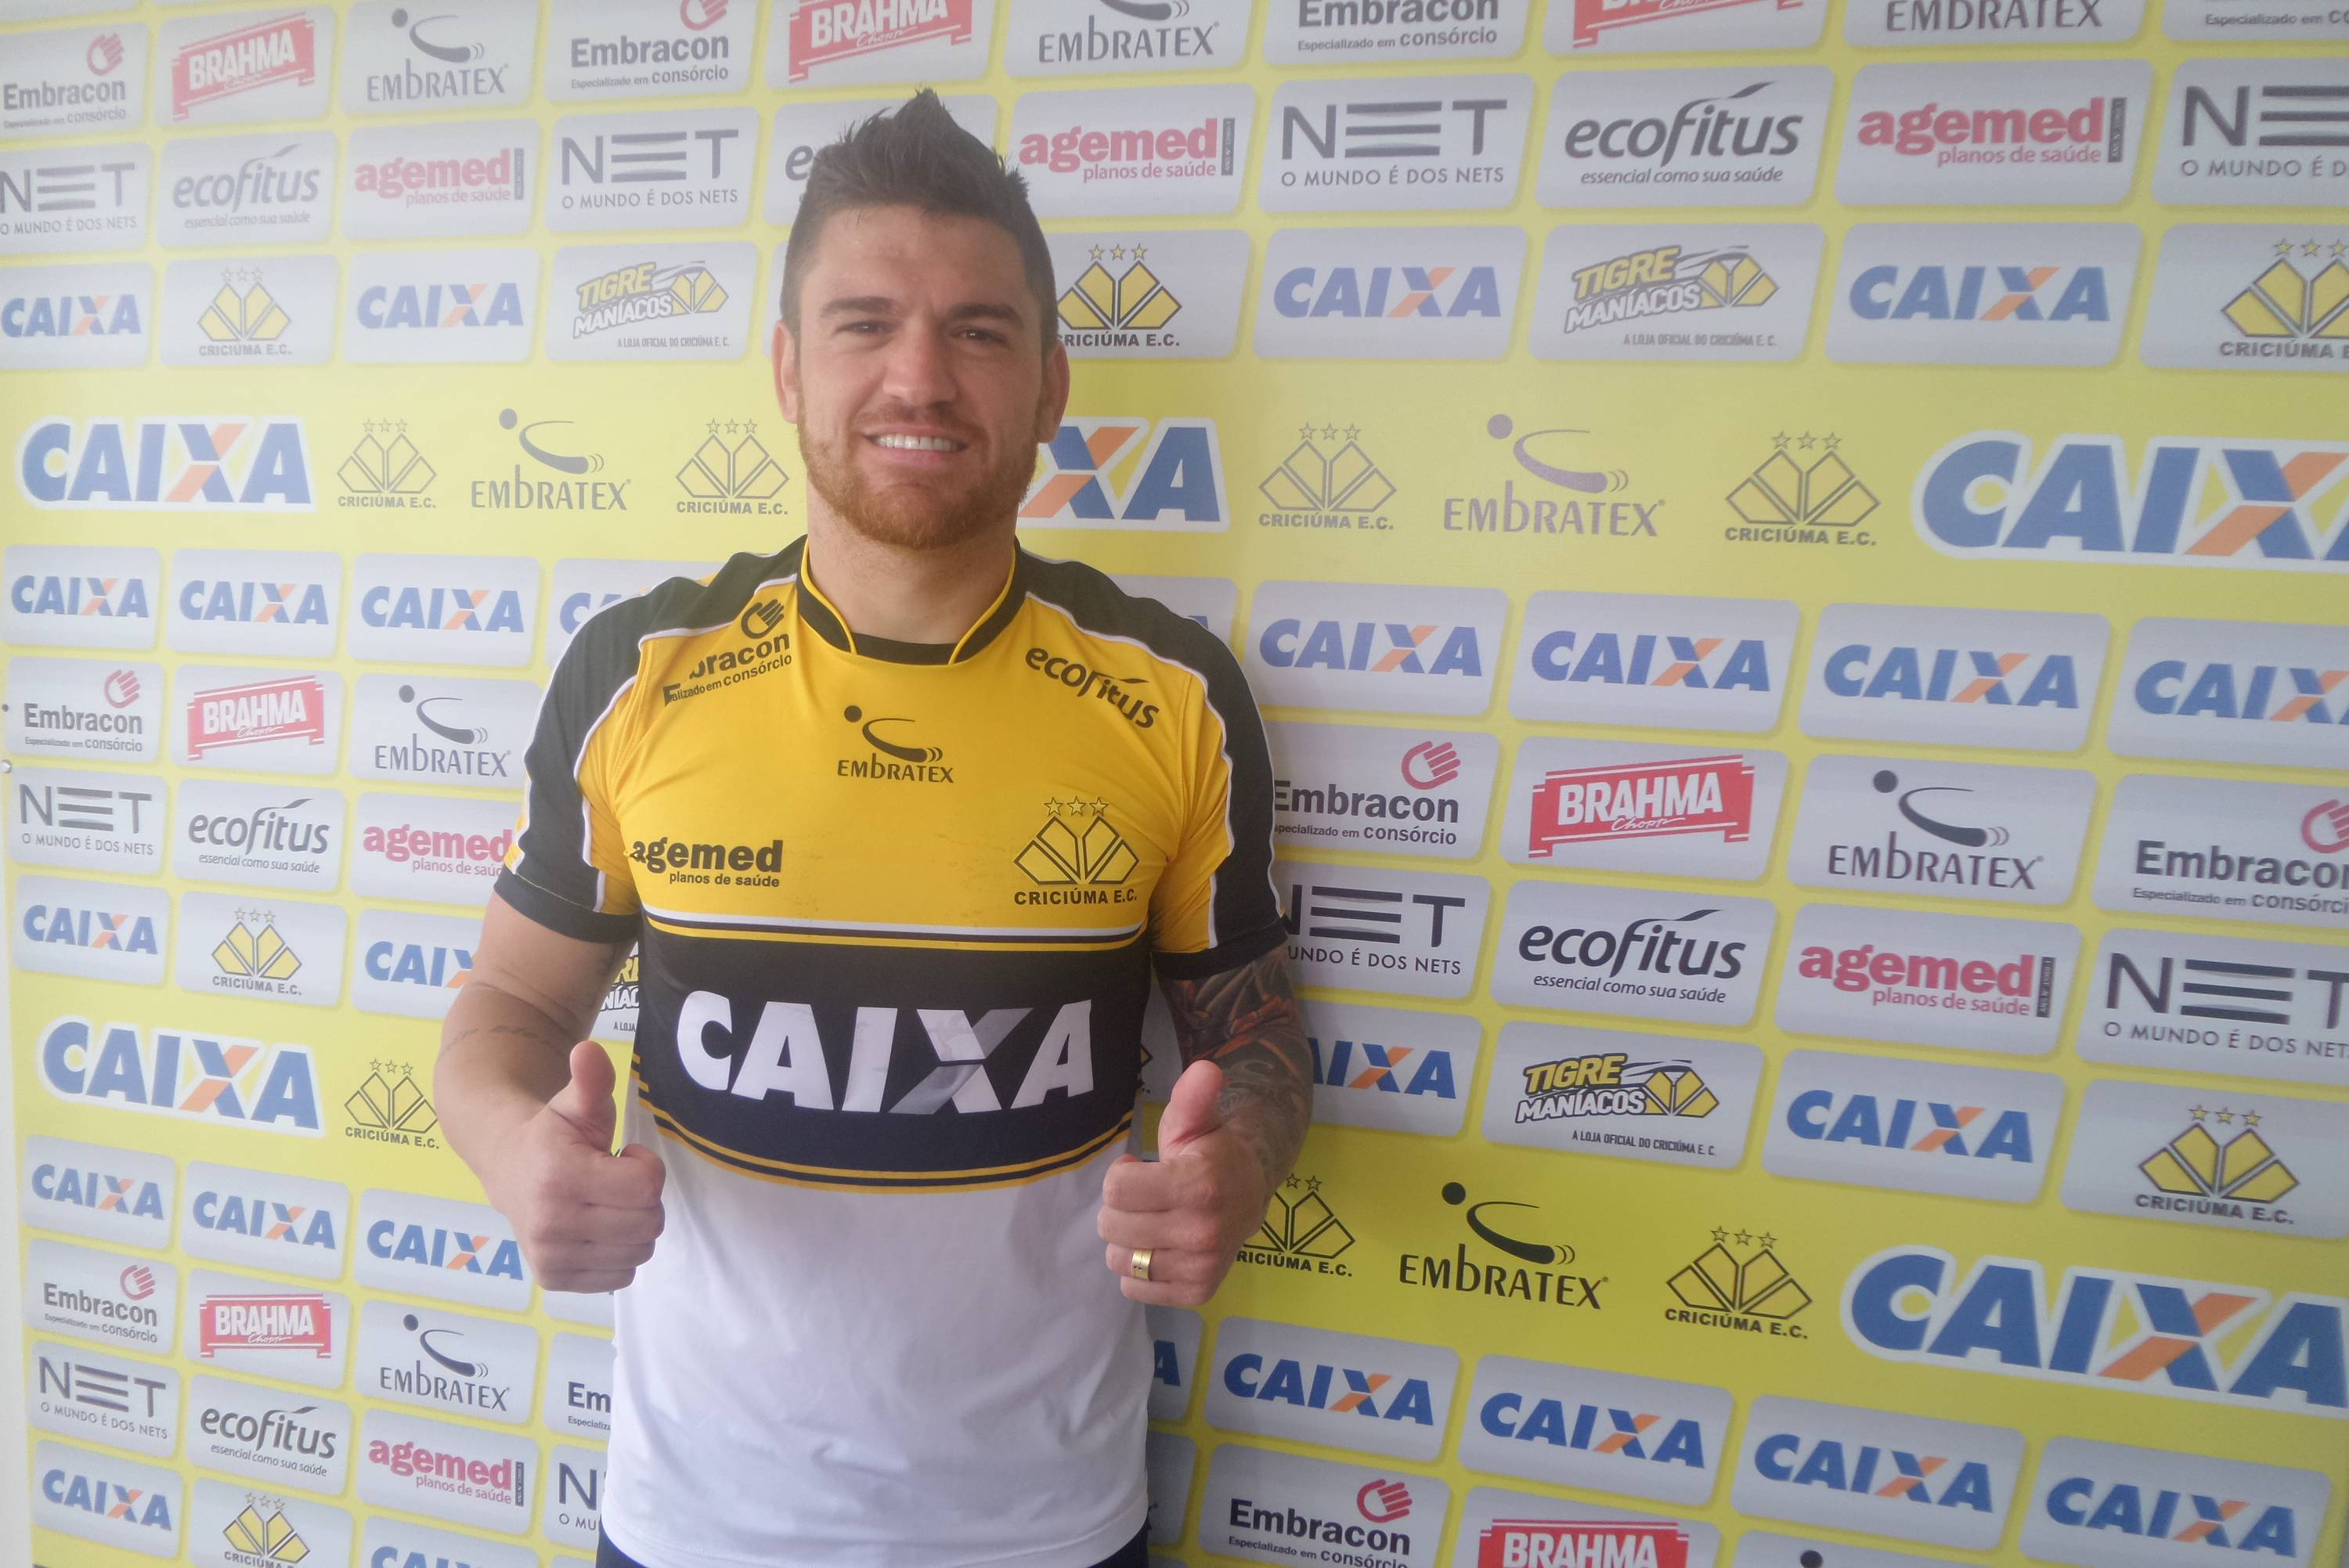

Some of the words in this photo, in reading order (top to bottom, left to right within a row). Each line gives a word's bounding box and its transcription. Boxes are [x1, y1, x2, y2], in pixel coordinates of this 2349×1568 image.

[811, 0, 949, 49] BRAHMA
[1297, 0, 1499, 27] Embracon
[189, 28, 296, 91] BRAHMA
[571, 34, 729, 67] Embracon
[1297, 38, 1374, 52] Especializado
[1377, 38, 1395, 47] em
[1399, 27, 1497, 47] consórcio
[3, 79, 125, 110] Embracon
[652, 66, 728, 83] consórcio
[1019, 118, 1218, 173] agemed
[1566, 81, 1803, 167] ecofitus
[1857, 98, 2104, 155] agemed
[173, 143, 320, 213] ecofitus
[355, 149, 511, 200] agemed
[1083, 164, 1137, 183] planos
[1141, 162, 1162, 178] de
[1166, 161, 1216, 178] saúde
[1281, 171, 1296, 187] O
[1304, 169, 1381, 186] MUNDO
[1389, 165, 1398, 184] É
[1407, 168, 1447, 184] DOS
[1456, 166, 1504, 183] NETS
[1581, 168, 1651, 185] essencial
[1654, 171, 1698, 184] como
[1702, 171, 1729, 183] sua
[1733, 166, 1783, 183] saúde
[1937, 147, 2004, 168] planos
[2008, 146, 2036, 163] de
[2040, 144, 2102, 163] saúde
[562, 196, 572, 209] O
[581, 191, 640, 209] MUNDO
[647, 189, 655, 207] É
[662, 190, 694, 205] DOS
[699, 189, 738, 204] NETS
[577, 262, 658, 310] TIGRE
[1273, 266, 1501, 319] CAIXA
[1572, 246, 1681, 302] TIGRE
[1849, 265, 2110, 322] CAIXA
[2, 294, 141, 338] CAIXA
[357, 283, 524, 329] CAIXA
[573, 289, 674, 338] MANÍACOS
[1564, 285, 1701, 333] MANÍACOS
[1064, 331, 1139, 346] RICIÚMA
[1146, 333, 1180, 346] E.C.
[2220, 339, 2333, 358] CRICIÚMA
[21, 422, 312, 504] CAIXA
[337, 494, 405, 507] CRICIÚMA
[410, 497, 436, 508] E.C.
[677, 500, 752, 514] CRICIÚMA
[758, 502, 788, 516] E.C.
[1259, 513, 1351, 528] CRICIÚMA
[1358, 514, 1394, 530] E.C.
[1725, 527, 1828, 544] CRICIÚMA
[1838, 531, 1877, 546] E.C.
[11, 575, 150, 619] CAIXA
[179, 580, 329, 625] CAIXA
[361, 586, 525, 633] CAIXA
[1259, 618, 1481, 677] CAIXA
[1532, 630, 1770, 692] CAIXA
[706, 680, 721, 691] em
[723, 654, 792, 686] consórcio
[1025, 647, 1160, 729] ecofitus
[1824, 644, 2079, 709] CAIXA
[2134, 660, 2349, 725] CAIX
[25, 703, 143, 735] Embracon
[204, 690, 308, 735] BRAHMA
[85, 737, 143, 752] consórcio
[1275, 780, 1459, 823] Embracon
[1558, 772, 1724, 826] BRAHMA
[22, 833, 31, 847] O
[35, 834, 80, 849] MUNDO
[85, 834, 91, 850] É
[95, 838, 121, 852] DOS
[124, 842, 153, 856] NETS
[189, 798, 329, 855] ecofitus
[363, 822, 512, 863] agemed
[1364, 826, 1456, 845] consórcio
[630, 838, 783, 875] agemed
[669, 871, 710, 885] planos
[714, 873, 731, 885] de
[736, 873, 780, 888] saúde
[1014, 888, 1109, 906] CRICIÚMA
[1113, 889, 1138, 904] E.C.
[23, 905, 158, 955] CAIXA
[1518, 909, 1746, 979] ecofitus
[212, 976, 272, 993] CRICIÚMA
[277, 982, 301, 995] E.C.
[1533, 973, 1602, 991] essencial
[1603, 979, 1646, 996] como
[1649, 982, 1676, 998] sua
[1679, 985, 1726, 1004] saúde
[1799, 944, 2035, 997] agemed
[1872, 986, 1937, 1010] planos
[1942, 989, 1967, 1010] de
[1971, 993, 2030, 1016] saúde
[677, 989, 1095, 1115] CAIXA
[43, 1021, 320, 1130] CAIXA
[1521, 1052, 1628, 1100] TIGRE
[1515, 1090, 1645, 1124] MANÍACOS
[1787, 1089, 2033, 1164] CAIXA
[345, 1126, 410, 1146] CRICIÚMA
[414, 1136, 439, 1149] E.C.
[1572, 1130, 1578, 1140] A
[1581, 1131, 1601, 1143] LOJA
[1604, 1134, 1636, 1147] OFICIAL
[1639, 1137, 1651, 1148] DO
[1654, 1140, 1695, 1153] CRICIÚMA
[31, 1164, 164, 1221] CAIXA
[2135, 1194, 2243, 1220] CRICIÚMA
[2250, 1206, 2294, 1225] E.C.
[192, 1191, 336, 1250] CAIXA
[366, 1219, 524, 1281] CAIXA
[1236, 1250, 1312, 1271] RICIÚMA
[1319, 1261, 1352, 1277] E.C.
[43, 1282, 158, 1328] Embracon
[215, 1304, 315, 1336] BRAHMA
[1665, 1308, 1762, 1336] CRICIÚMA
[1770, 1321, 1809, 1340] E.C.
[102, 1319, 158, 1344] consórcio
[1851, 1253, 2349, 1408] CAIXA
[1223, 1353, 1434, 1427] CAIXA
[200, 1406, 337, 1461] ecofitus
[1480, 1392, 1705, 1470] CAIXA
[368, 1439, 513, 1491] agemed
[1755, 1433, 1993, 1514] CAIXA
[42, 1469, 173, 1531] CAIXA
[2046, 1476, 2296, 1558] CAIXA
[1229, 1498, 1410, 1557] Embracon
[1229, 1535, 1297, 1558] Especializado
[1301, 1548, 1317, 1559] em
[1505, 1531, 1658, 1568] BRAHMA
